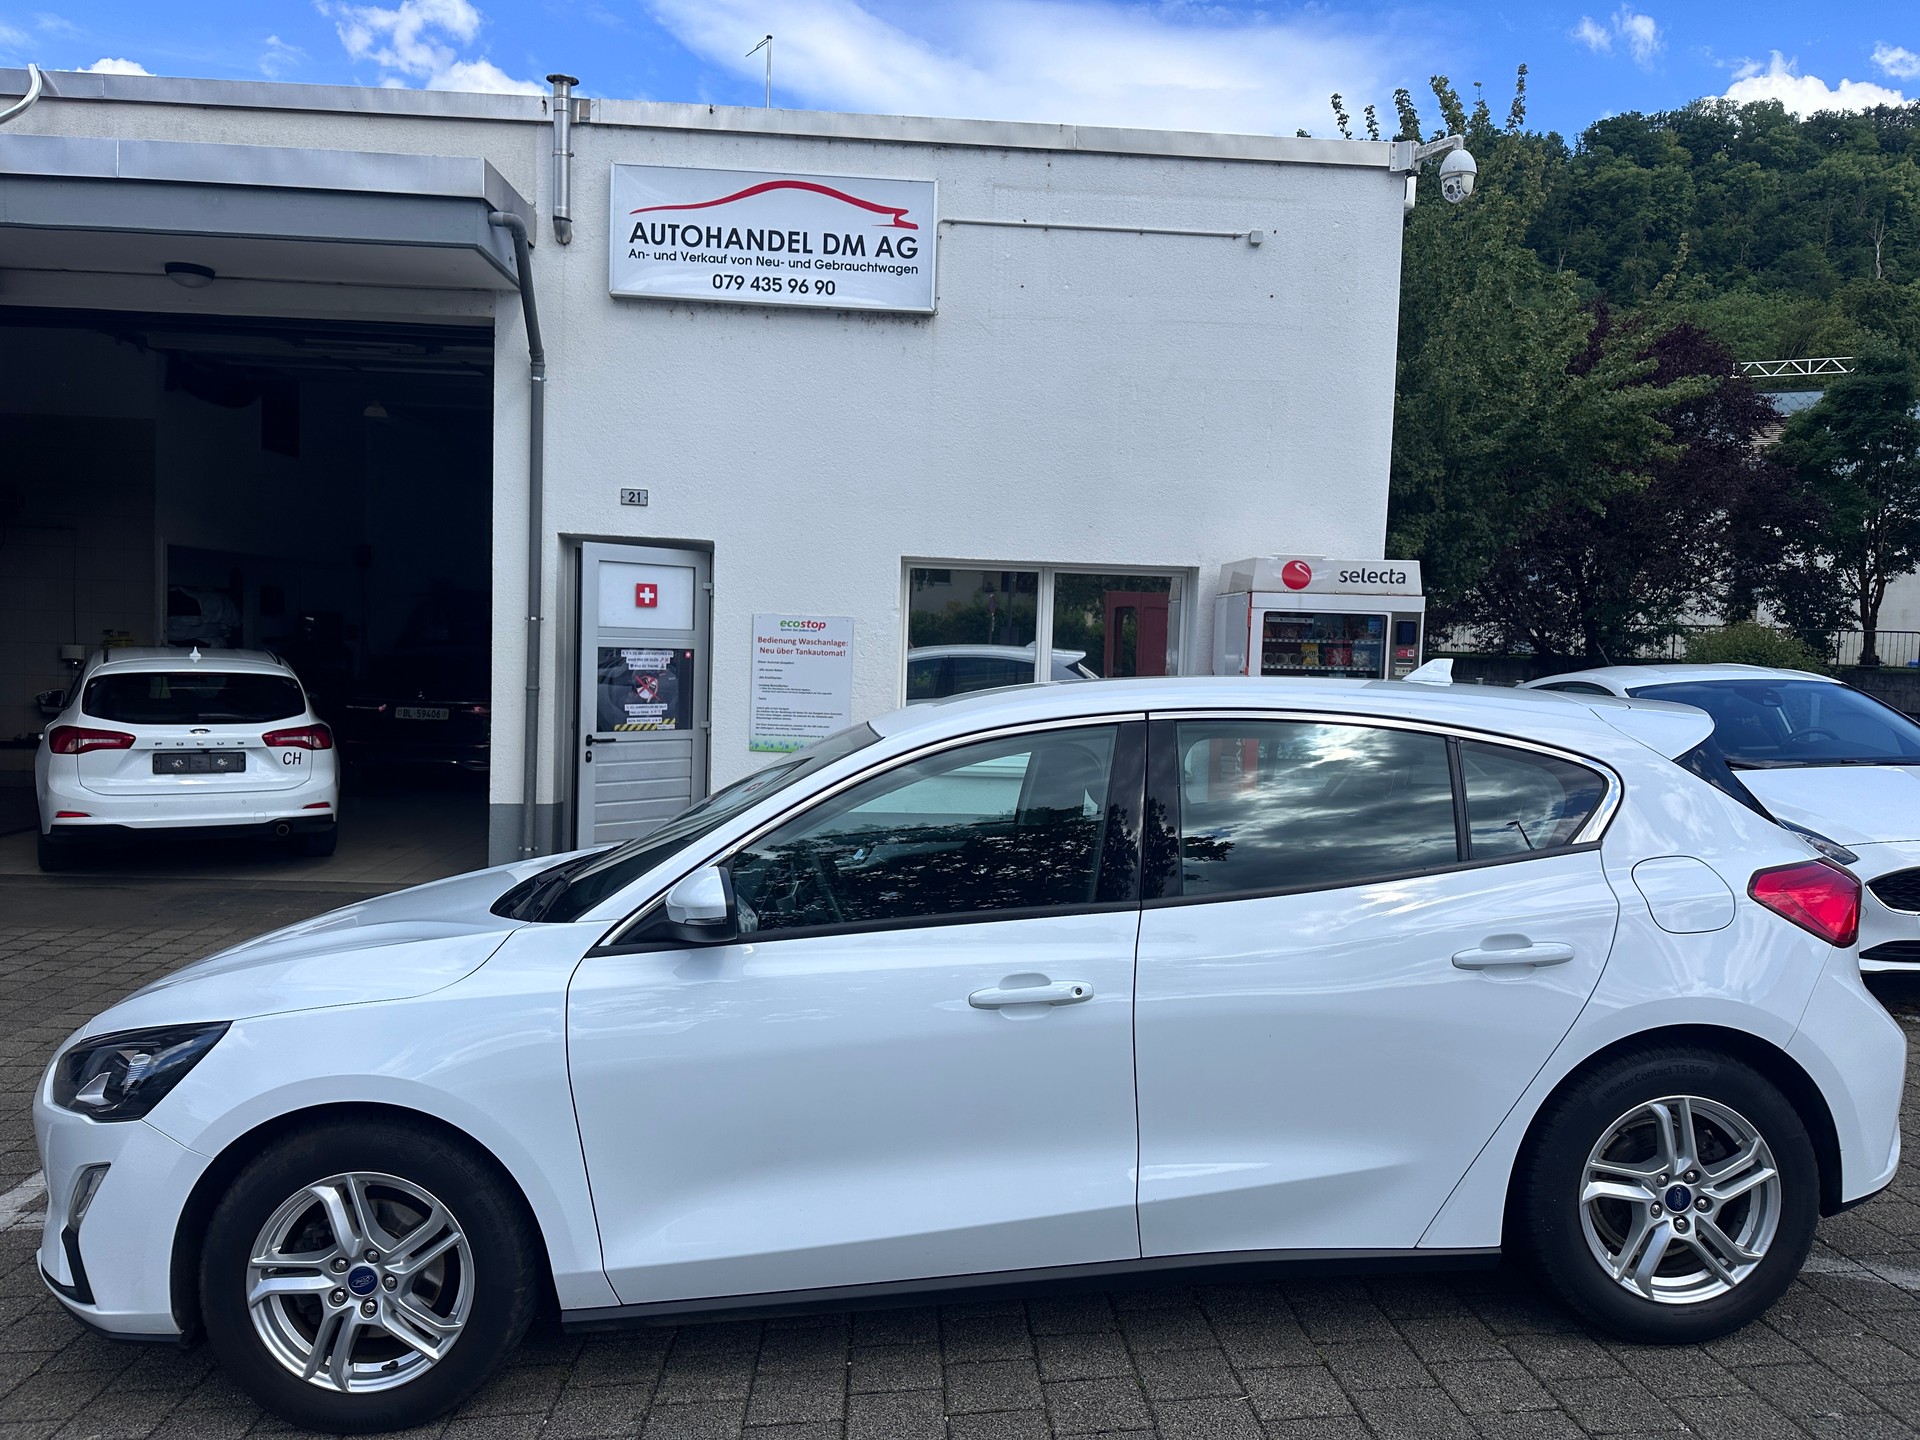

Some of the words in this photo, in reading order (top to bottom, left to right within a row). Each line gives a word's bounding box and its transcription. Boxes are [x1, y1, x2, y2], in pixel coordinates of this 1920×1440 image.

[628, 221, 814, 255] AUTOHANDEL
[822, 232, 866, 258] DM
[874, 235, 919, 260] AG
[628, 248, 650, 260] An-
[653, 250, 677, 261] und
[680, 251, 728, 265] Verkauf
[730, 255, 752, 266] von
[755, 256, 785, 268] Neu-
[788, 259, 811, 269] und
[814, 259, 919, 277] Gebrauchtwagen
[712, 273, 745, 291] 079
[750, 276, 783, 293] 435
[787, 278, 809, 294] 96
[814, 279, 836, 296] 90
[628, 491, 641, 503] 21
[1338, 567, 1407, 585] selecta
[779, 620, 827, 631] ecostop
[757, 636, 797, 646] Bedienung
[798, 637, 849, 648] Waschanlage:
[759, 646, 775, 655] Neu
[776, 647, 794, 655] über
[795, 648, 846, 657] Tankautomat!
[282, 751, 302, 765] CH
